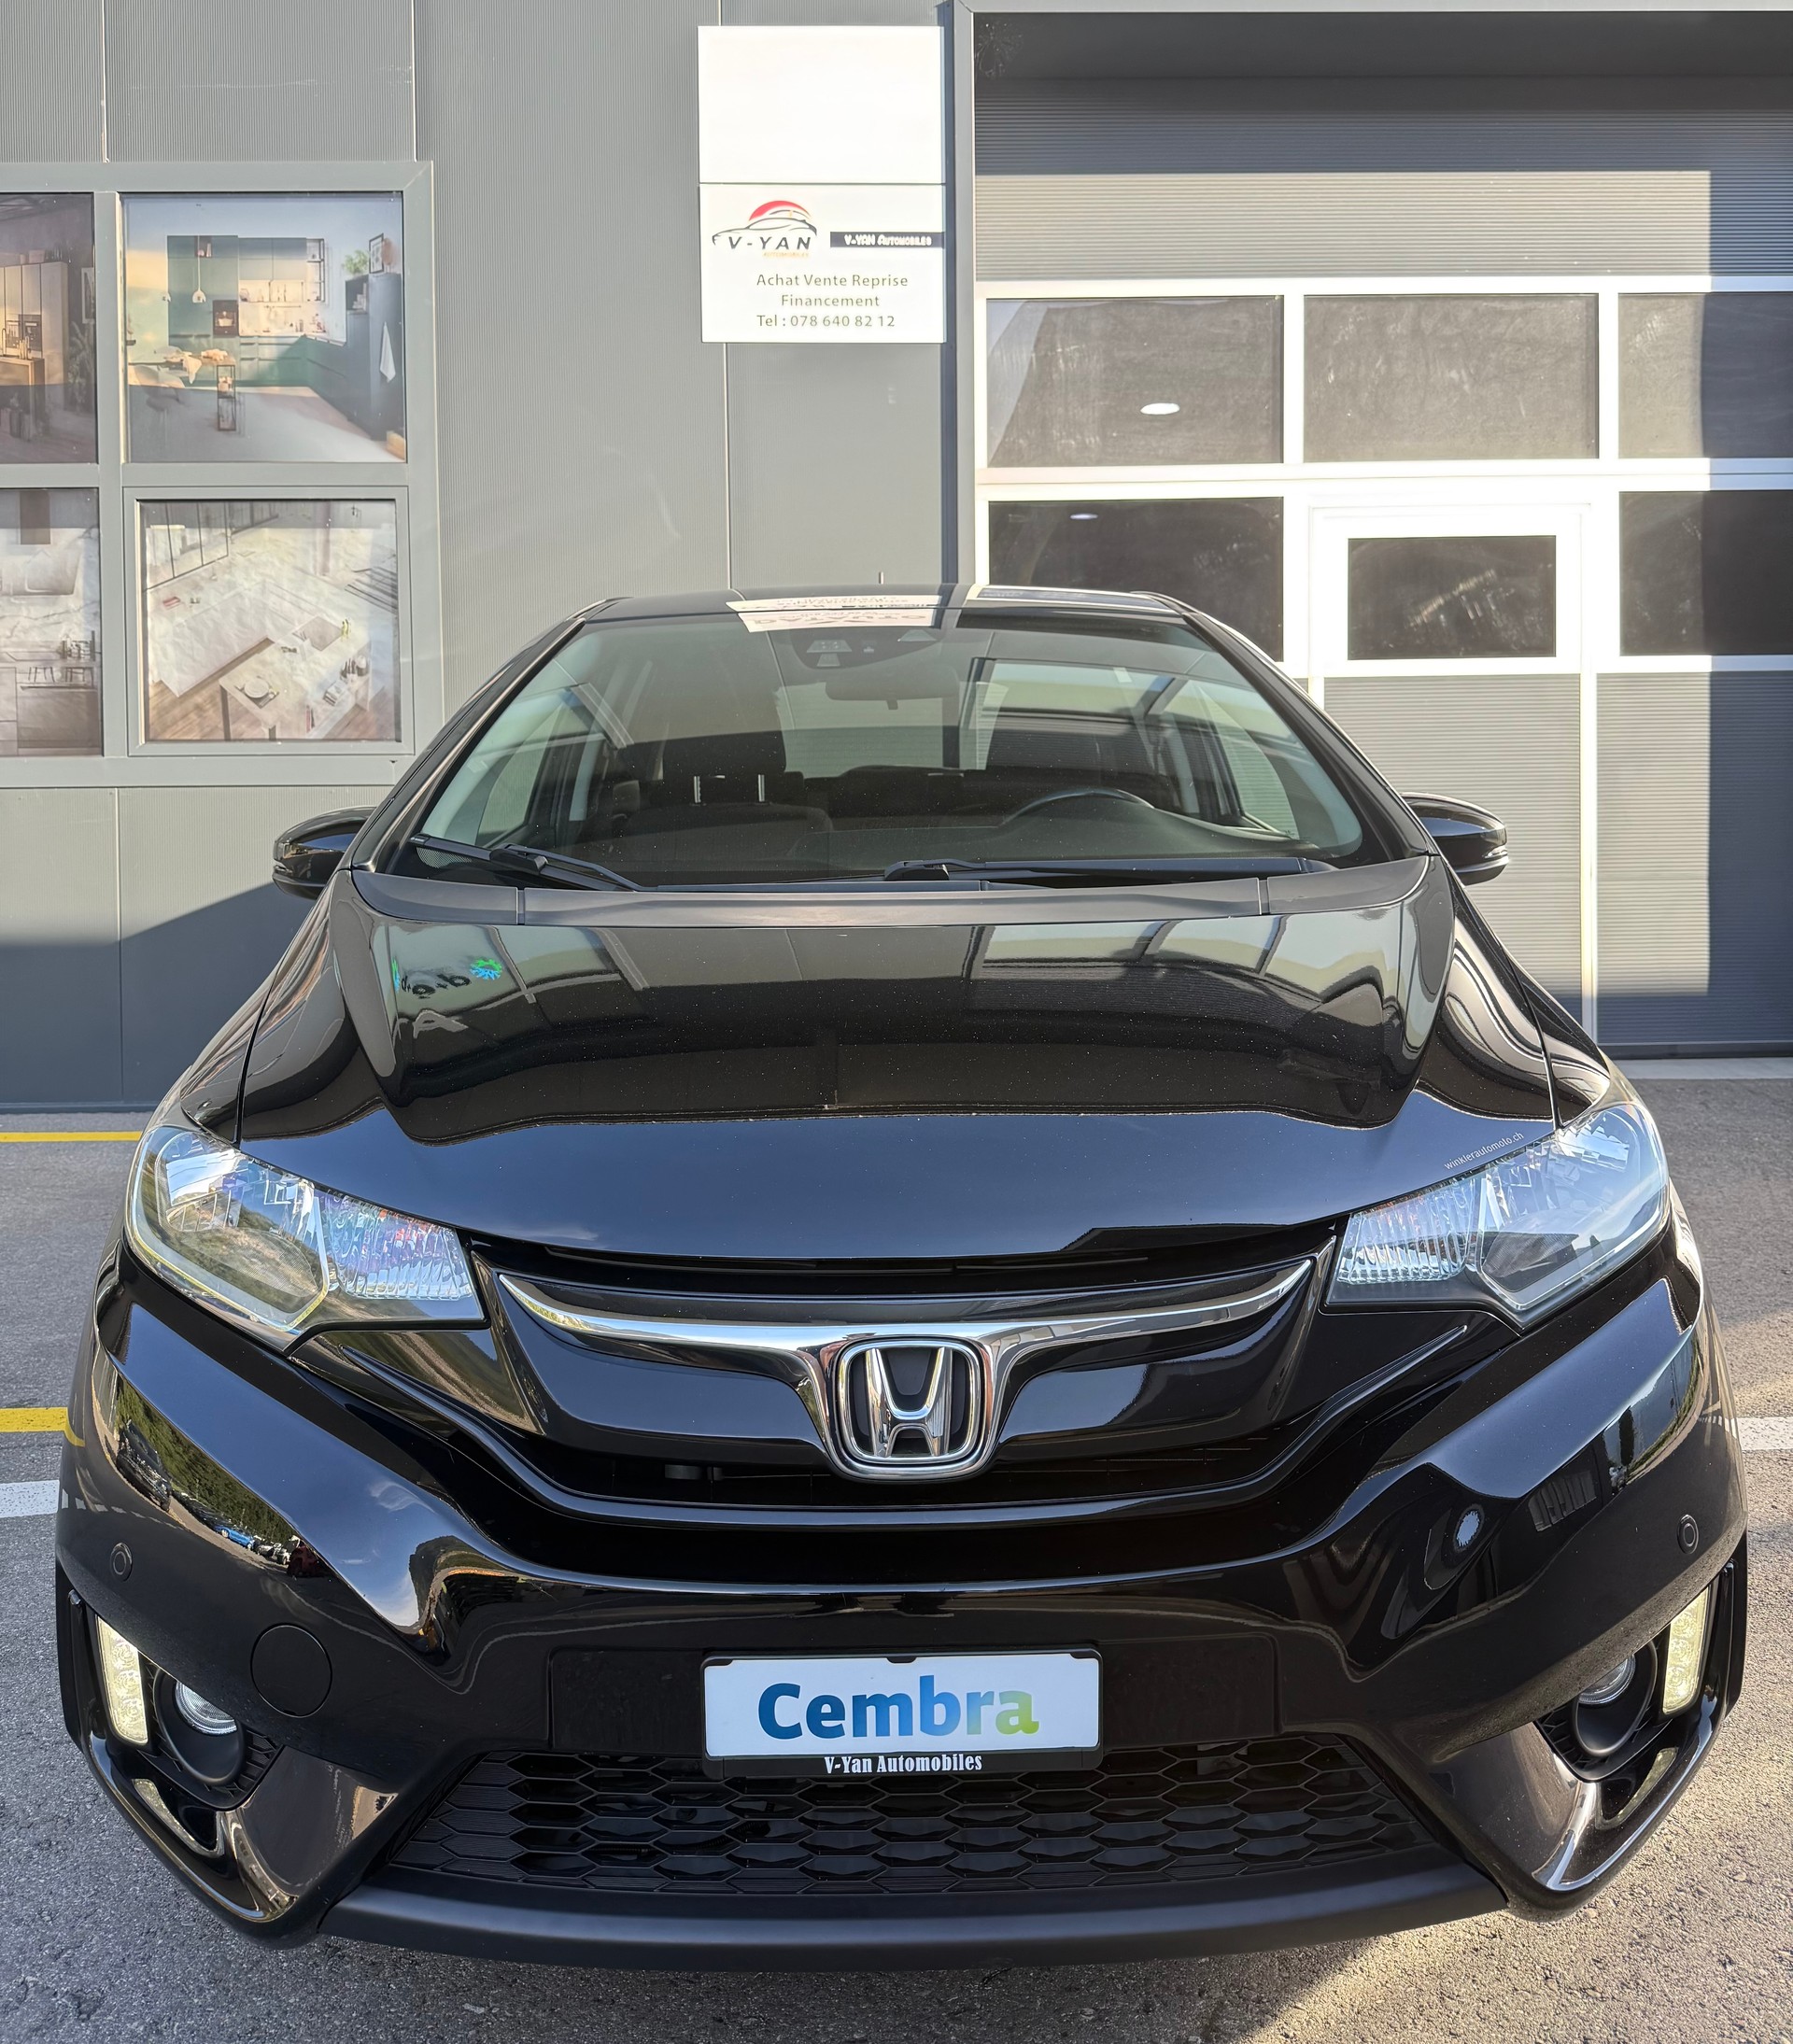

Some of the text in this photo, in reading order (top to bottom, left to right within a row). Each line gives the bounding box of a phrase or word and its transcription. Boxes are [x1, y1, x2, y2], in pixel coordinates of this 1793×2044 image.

[728, 236, 811, 249] V-YAN
[844, 233, 875, 246] V-YAN
[756, 274, 909, 289] Achat Vente Reprise
[781, 294, 880, 307] Financement
[756, 315, 778, 327] Tel
[790, 315, 818, 327] 078
[823, 315, 850, 327] 640
[854, 315, 872, 327] 82
[879, 315, 896, 327] 12
[1444, 1132, 1525, 1170] winklerautomoto.ch
[757, 1674, 1040, 1741] Cembra
[824, 1753, 982, 1775] V-Yan Automobiles
